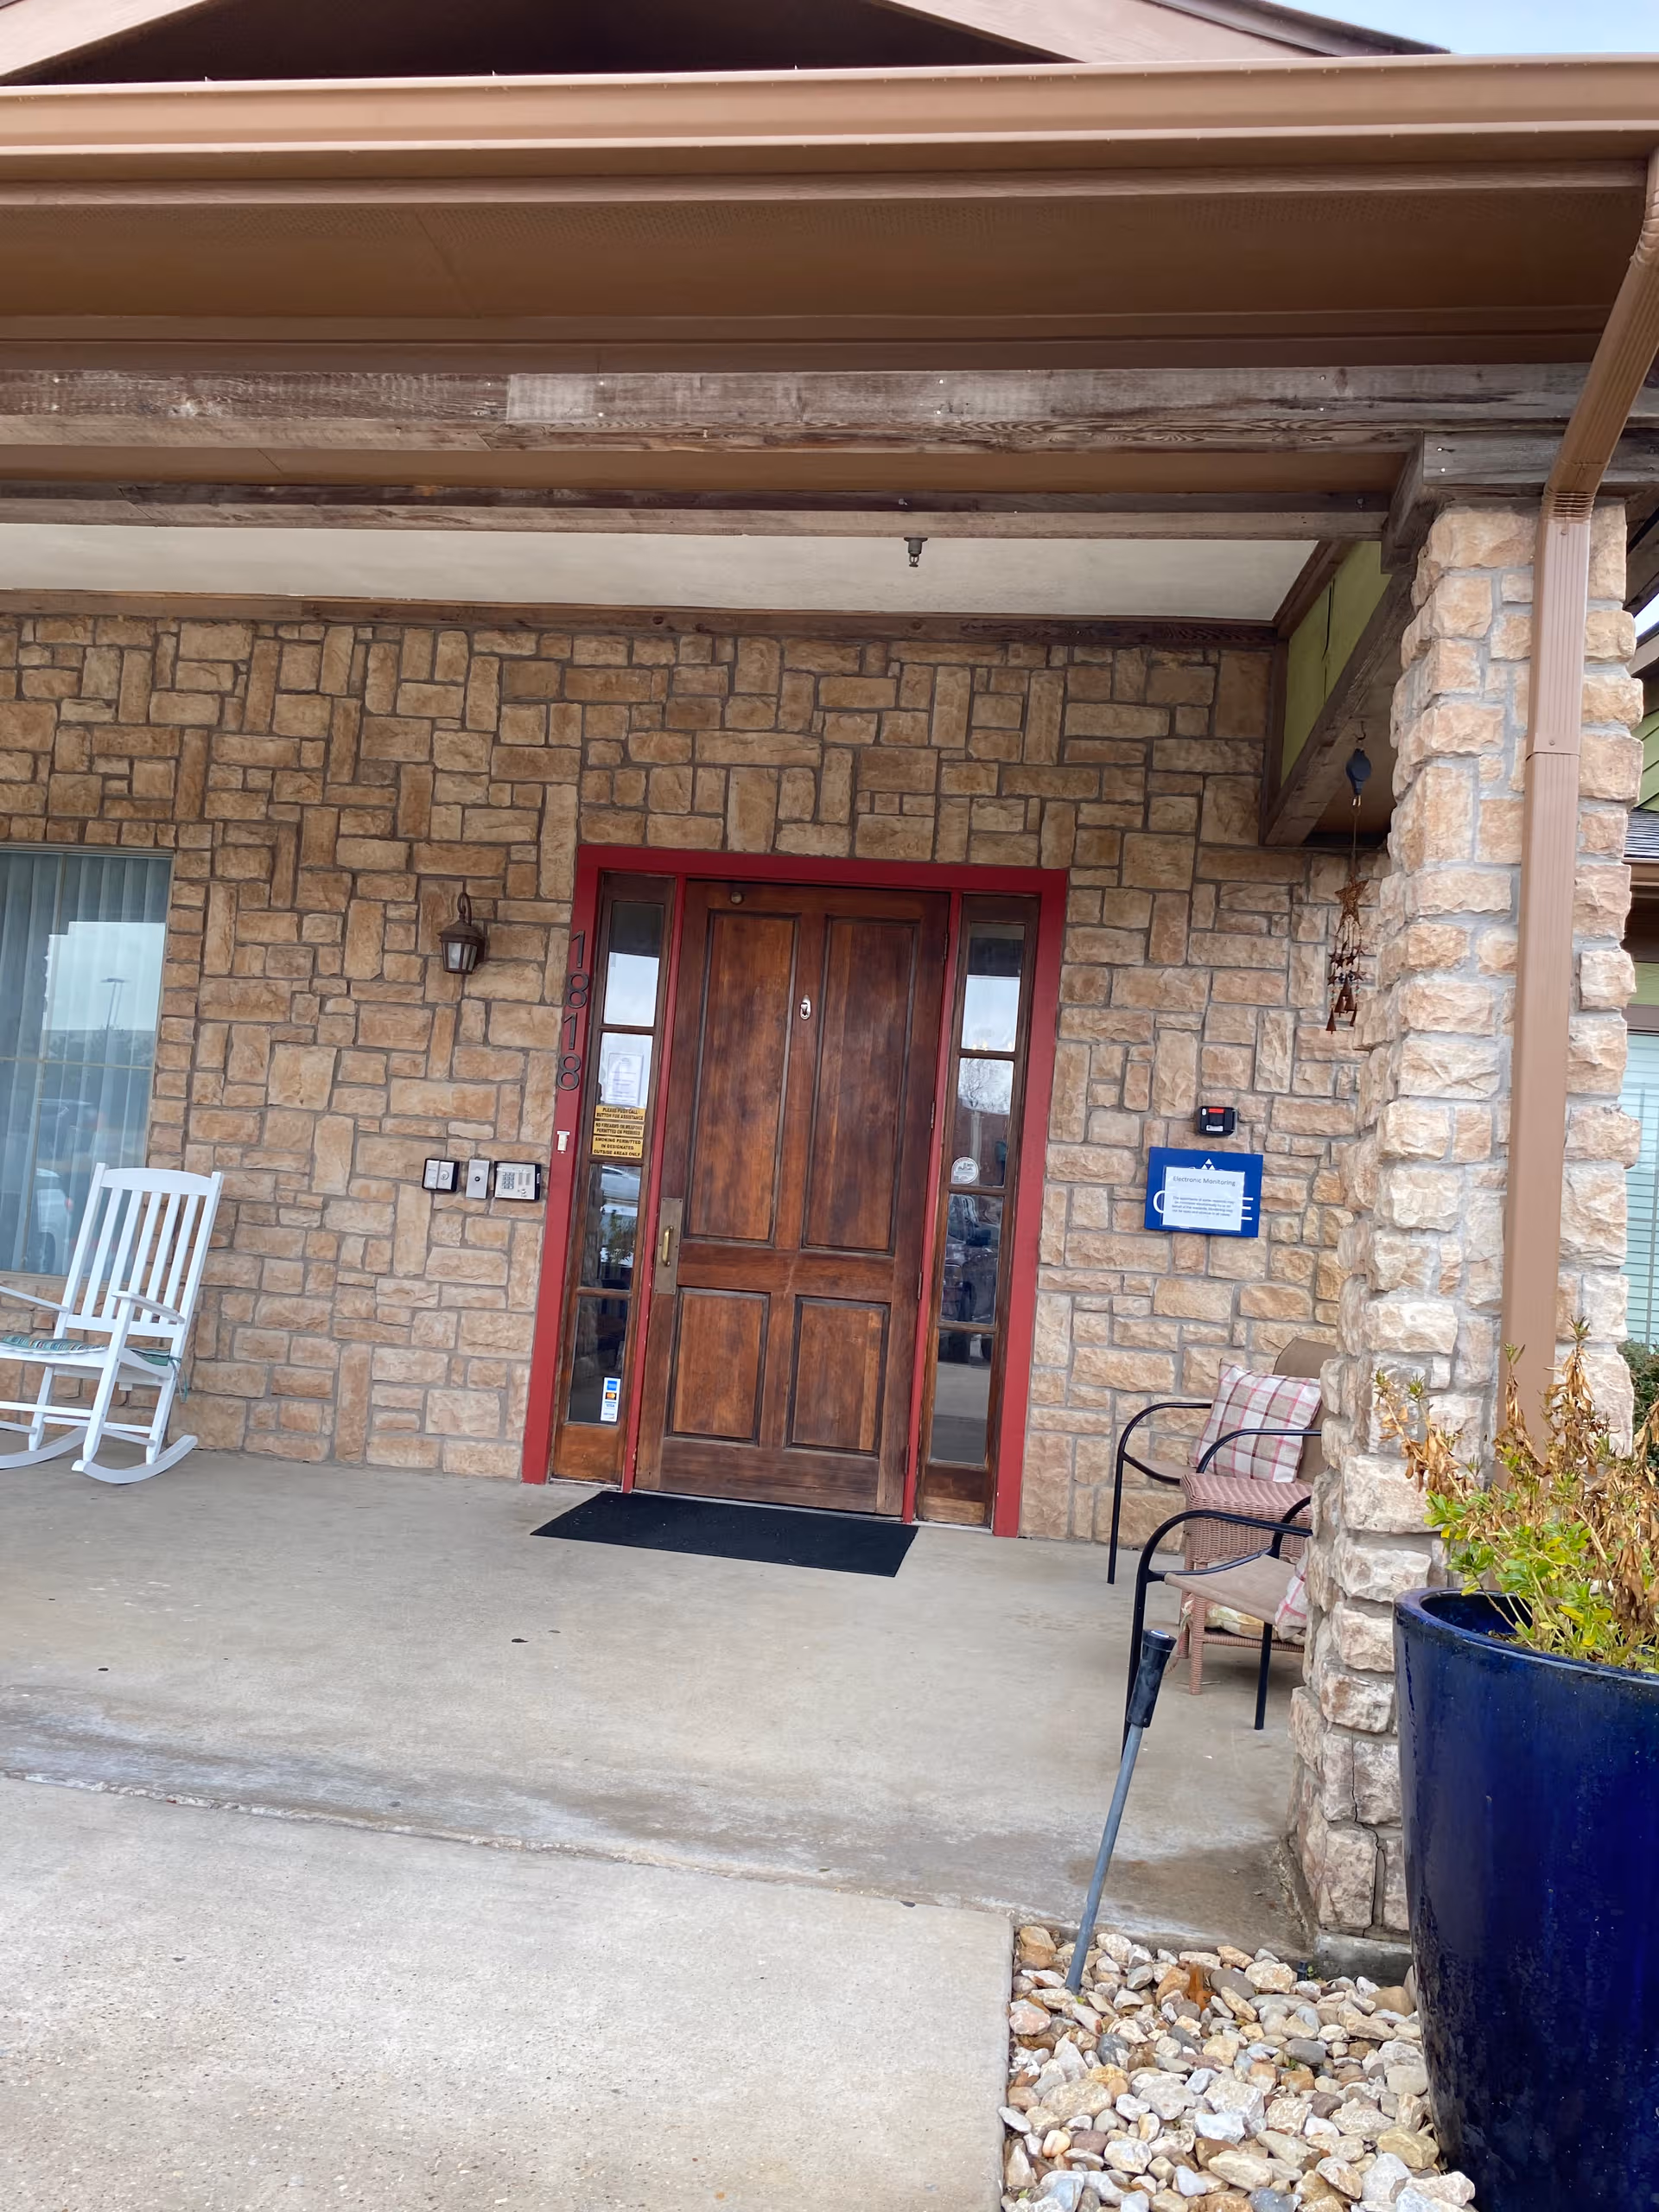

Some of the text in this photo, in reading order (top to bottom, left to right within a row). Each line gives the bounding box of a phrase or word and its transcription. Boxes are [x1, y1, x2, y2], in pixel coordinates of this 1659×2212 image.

[556, 930, 589, 1090] 1818
[1173, 1175, 1236, 1187] Electronic Monitoring
